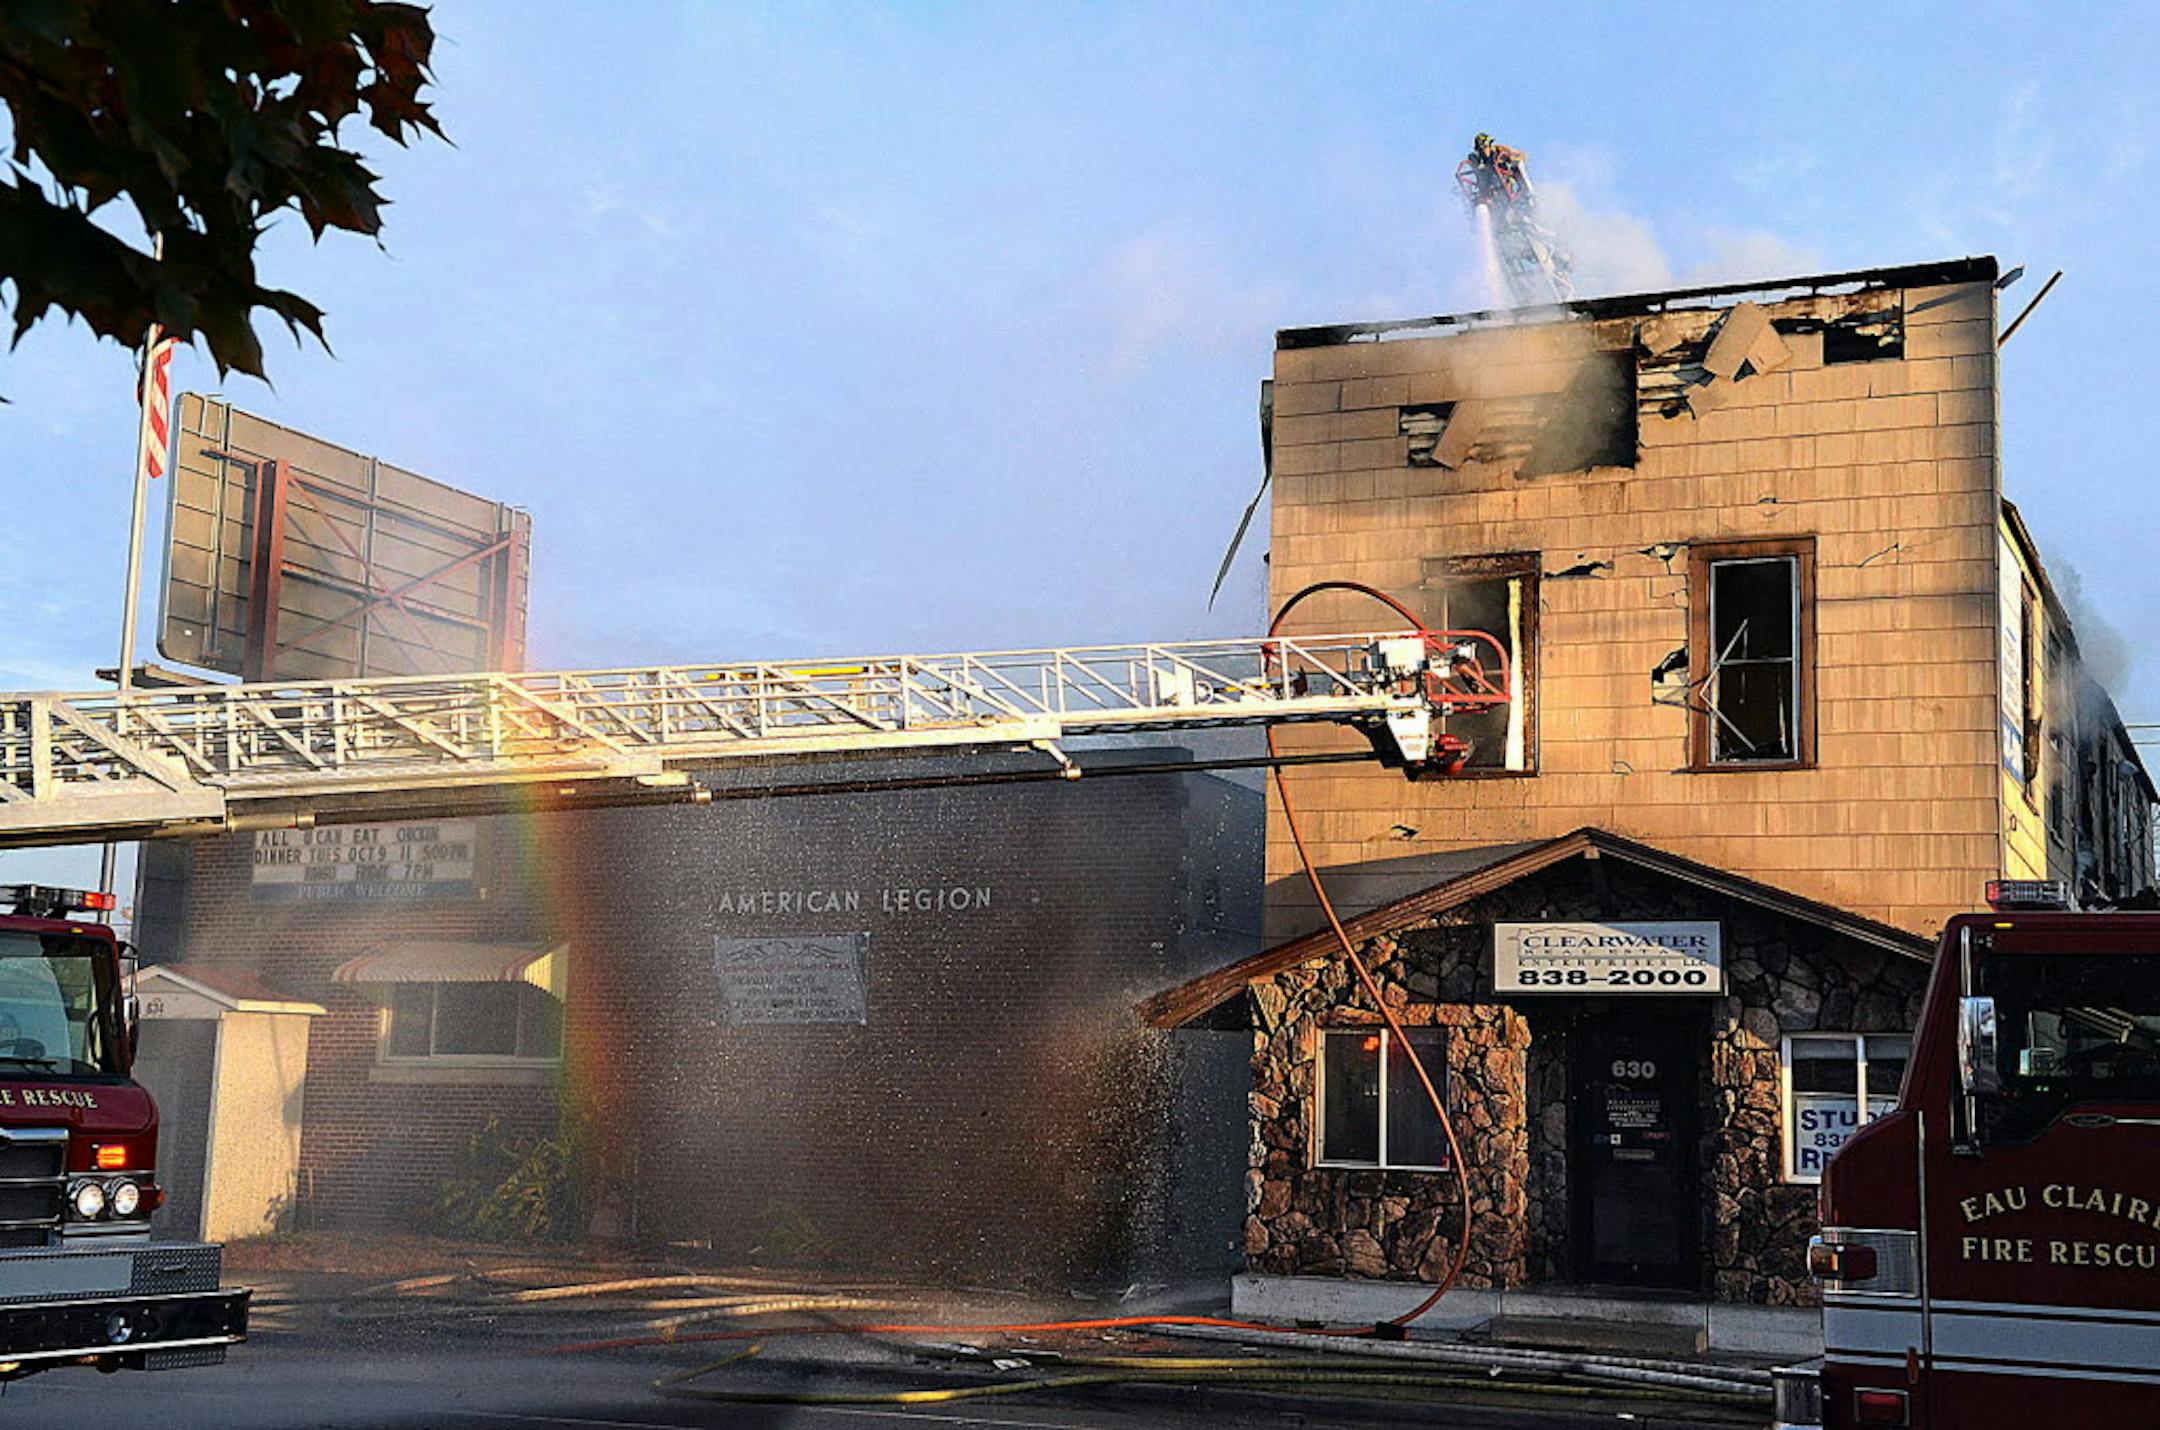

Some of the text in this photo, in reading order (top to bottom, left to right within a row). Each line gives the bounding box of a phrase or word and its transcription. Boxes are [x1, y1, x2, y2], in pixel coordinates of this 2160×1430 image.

[261, 831, 289, 846] ALL
[353, 829, 380, 843] EAT
[254, 849, 301, 864] DINNER
[300, 883, 425, 900] PUBLIC WELCOME
[718, 886, 991, 914] AMERICAN LEGION
[1523, 935, 1708, 948] CLEARWATER
[1518, 969, 1707, 986] 838-2000
[1612, 1060, 1656, 1079] 630
[22, 1088, 98, 1109] RESCUE
[1960, 1186, 2027, 1222] EAU
[1962, 1236, 2033, 1263] FIRE
